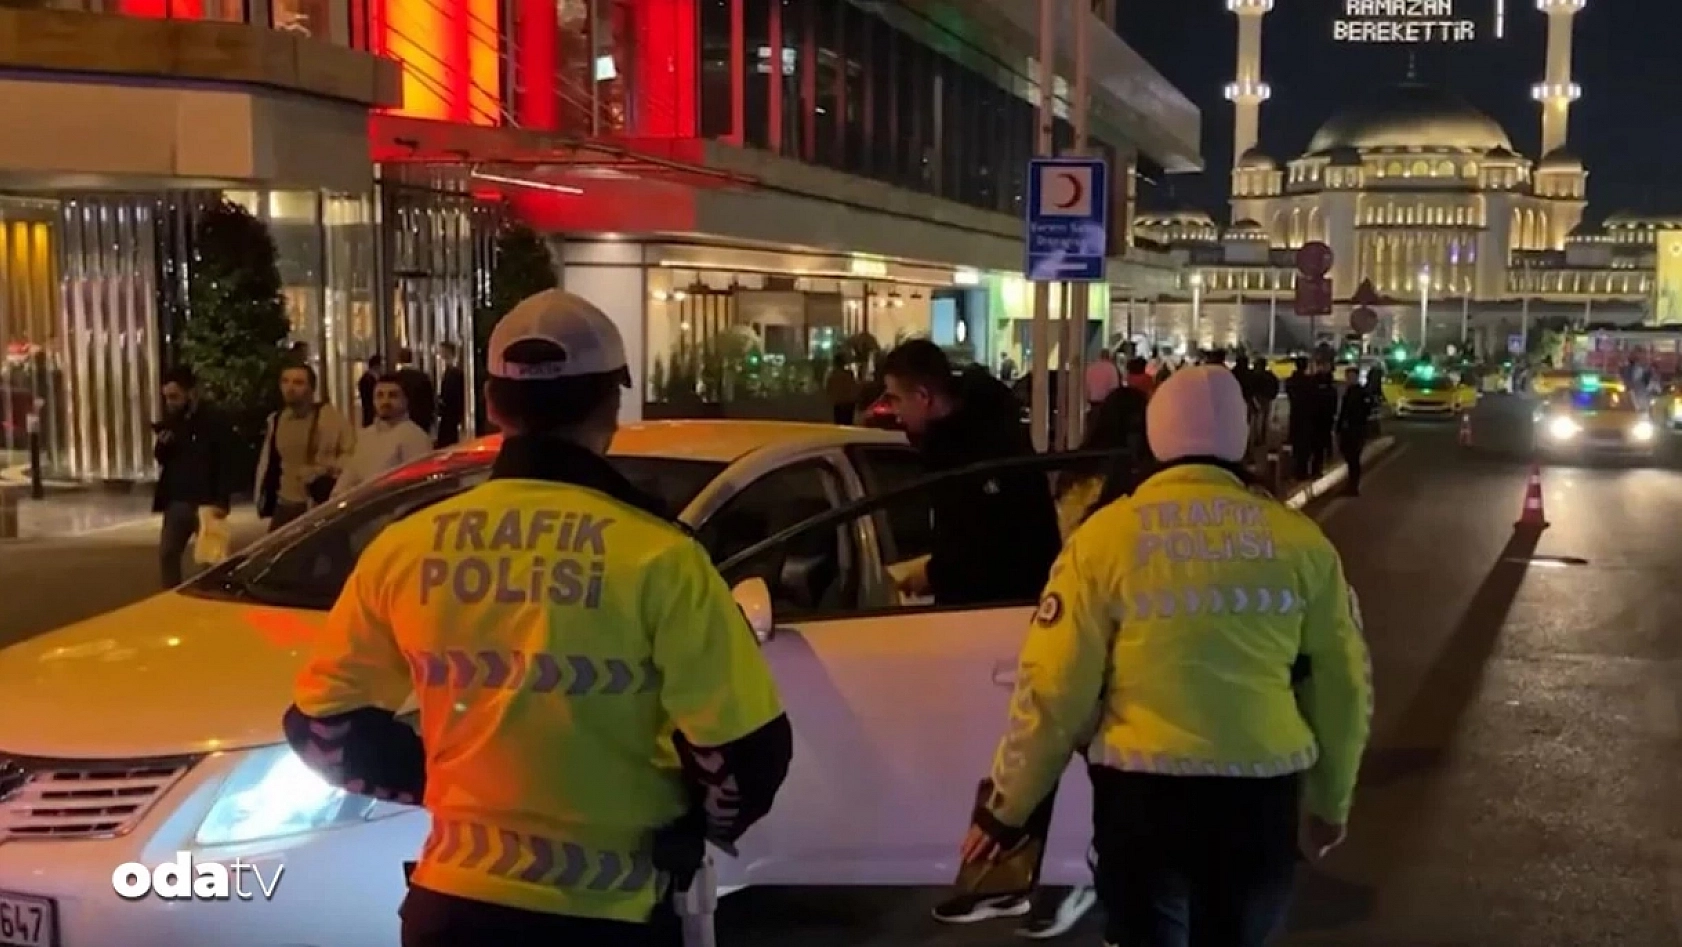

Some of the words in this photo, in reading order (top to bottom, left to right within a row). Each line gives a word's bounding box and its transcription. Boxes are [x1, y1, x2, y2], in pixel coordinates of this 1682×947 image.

[1347, 0, 1451, 15] RAMAZAN
[1333, 20, 1475, 41] BEREKETTİR
[431, 508, 616, 556] TRAFİK
[420, 556, 605, 609] POLİSİ
[0, 902, 43, 943] 647
